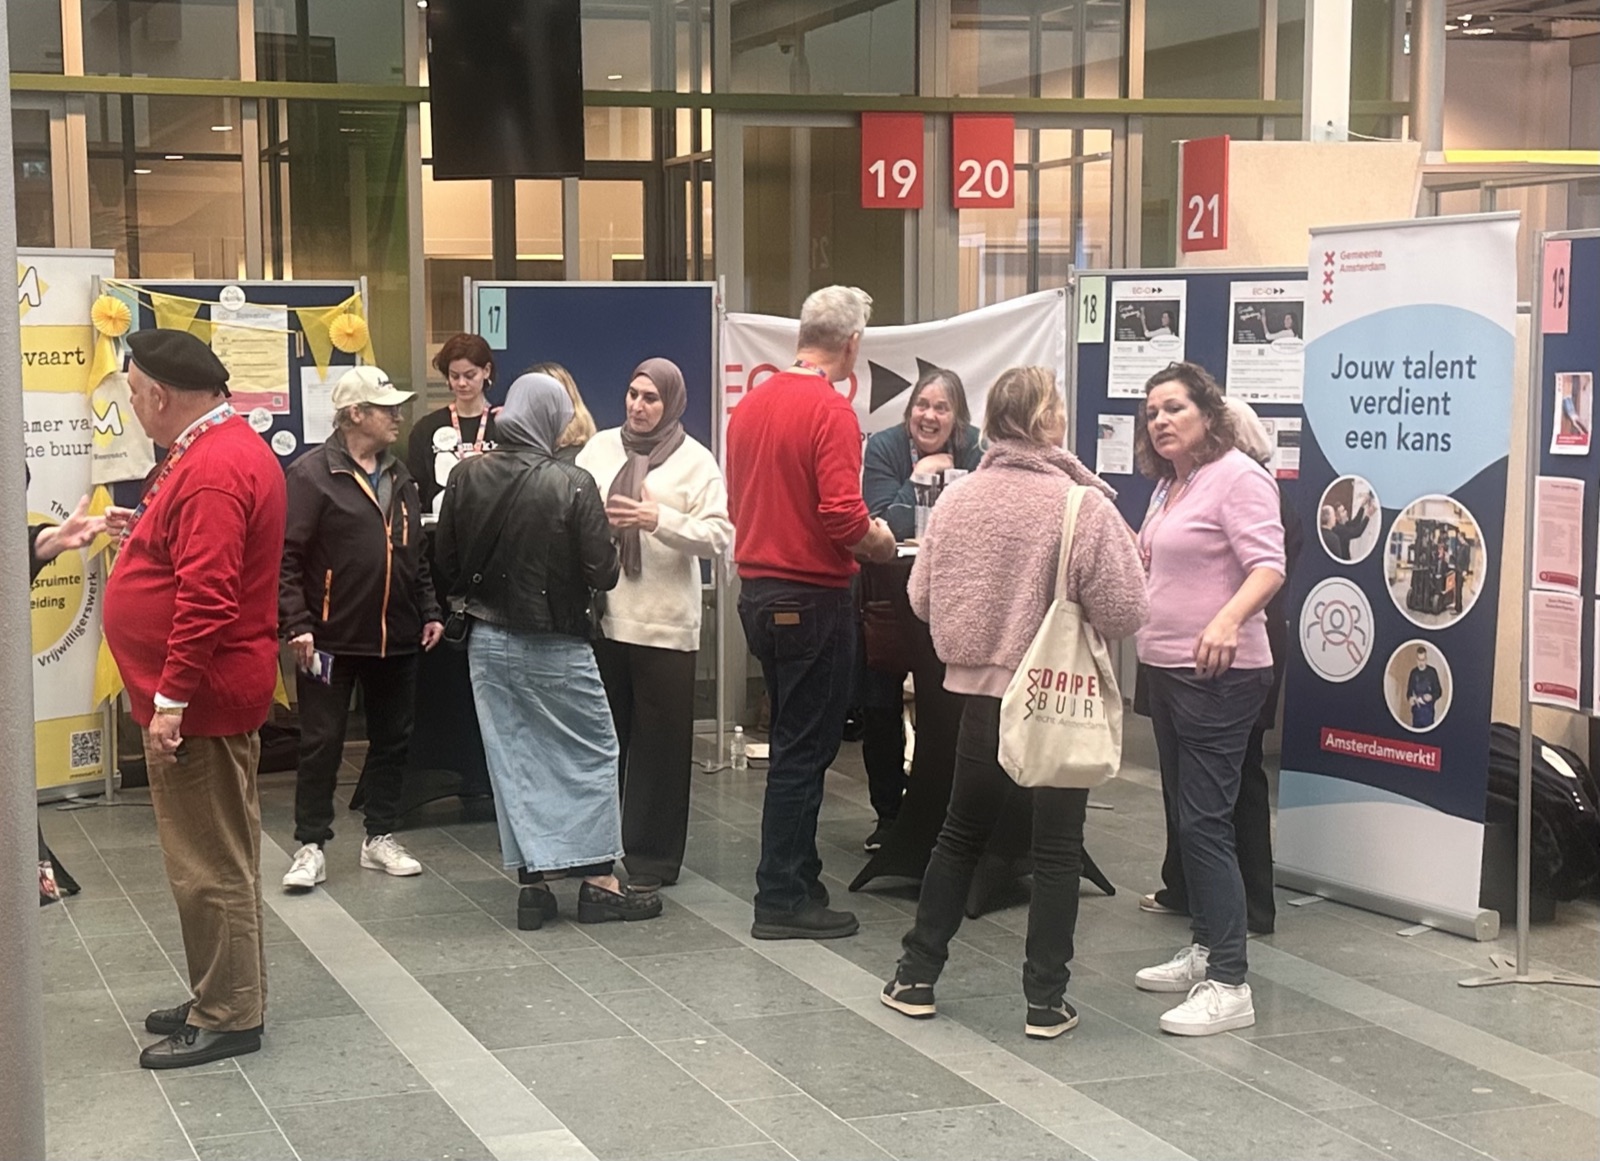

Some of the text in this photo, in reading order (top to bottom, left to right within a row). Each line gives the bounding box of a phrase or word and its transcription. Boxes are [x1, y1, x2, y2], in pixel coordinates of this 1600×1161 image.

[868, 159, 917, 198] 19
[957, 159, 1010, 198] 20
[1187, 193, 1220, 240] 21
[1340, 250, 1383, 260] Gemeente
[1340, 262, 1386, 273] Amsterdam
[1552, 267, 1565, 309] 19
[487, 305, 501, 334] 17
[1082, 294, 1098, 325] 18
[21, 346, 86, 367] vaart
[1331, 353, 1394, 381] Jouw
[1403, 350, 1477, 380] talent
[1350, 386, 1451, 416] verdient
[24, 418, 93, 433] amer va
[1345, 422, 1452, 452] een kans
[50, 442, 92, 456] buur
[50, 500, 71, 520] The
[31, 575, 81, 591] sruimte
[30, 596, 66, 610] eiding
[37, 571, 97, 667] Vrijwilligerswerk
[1325, 732, 1436, 767] Amsterdamwerkt!
